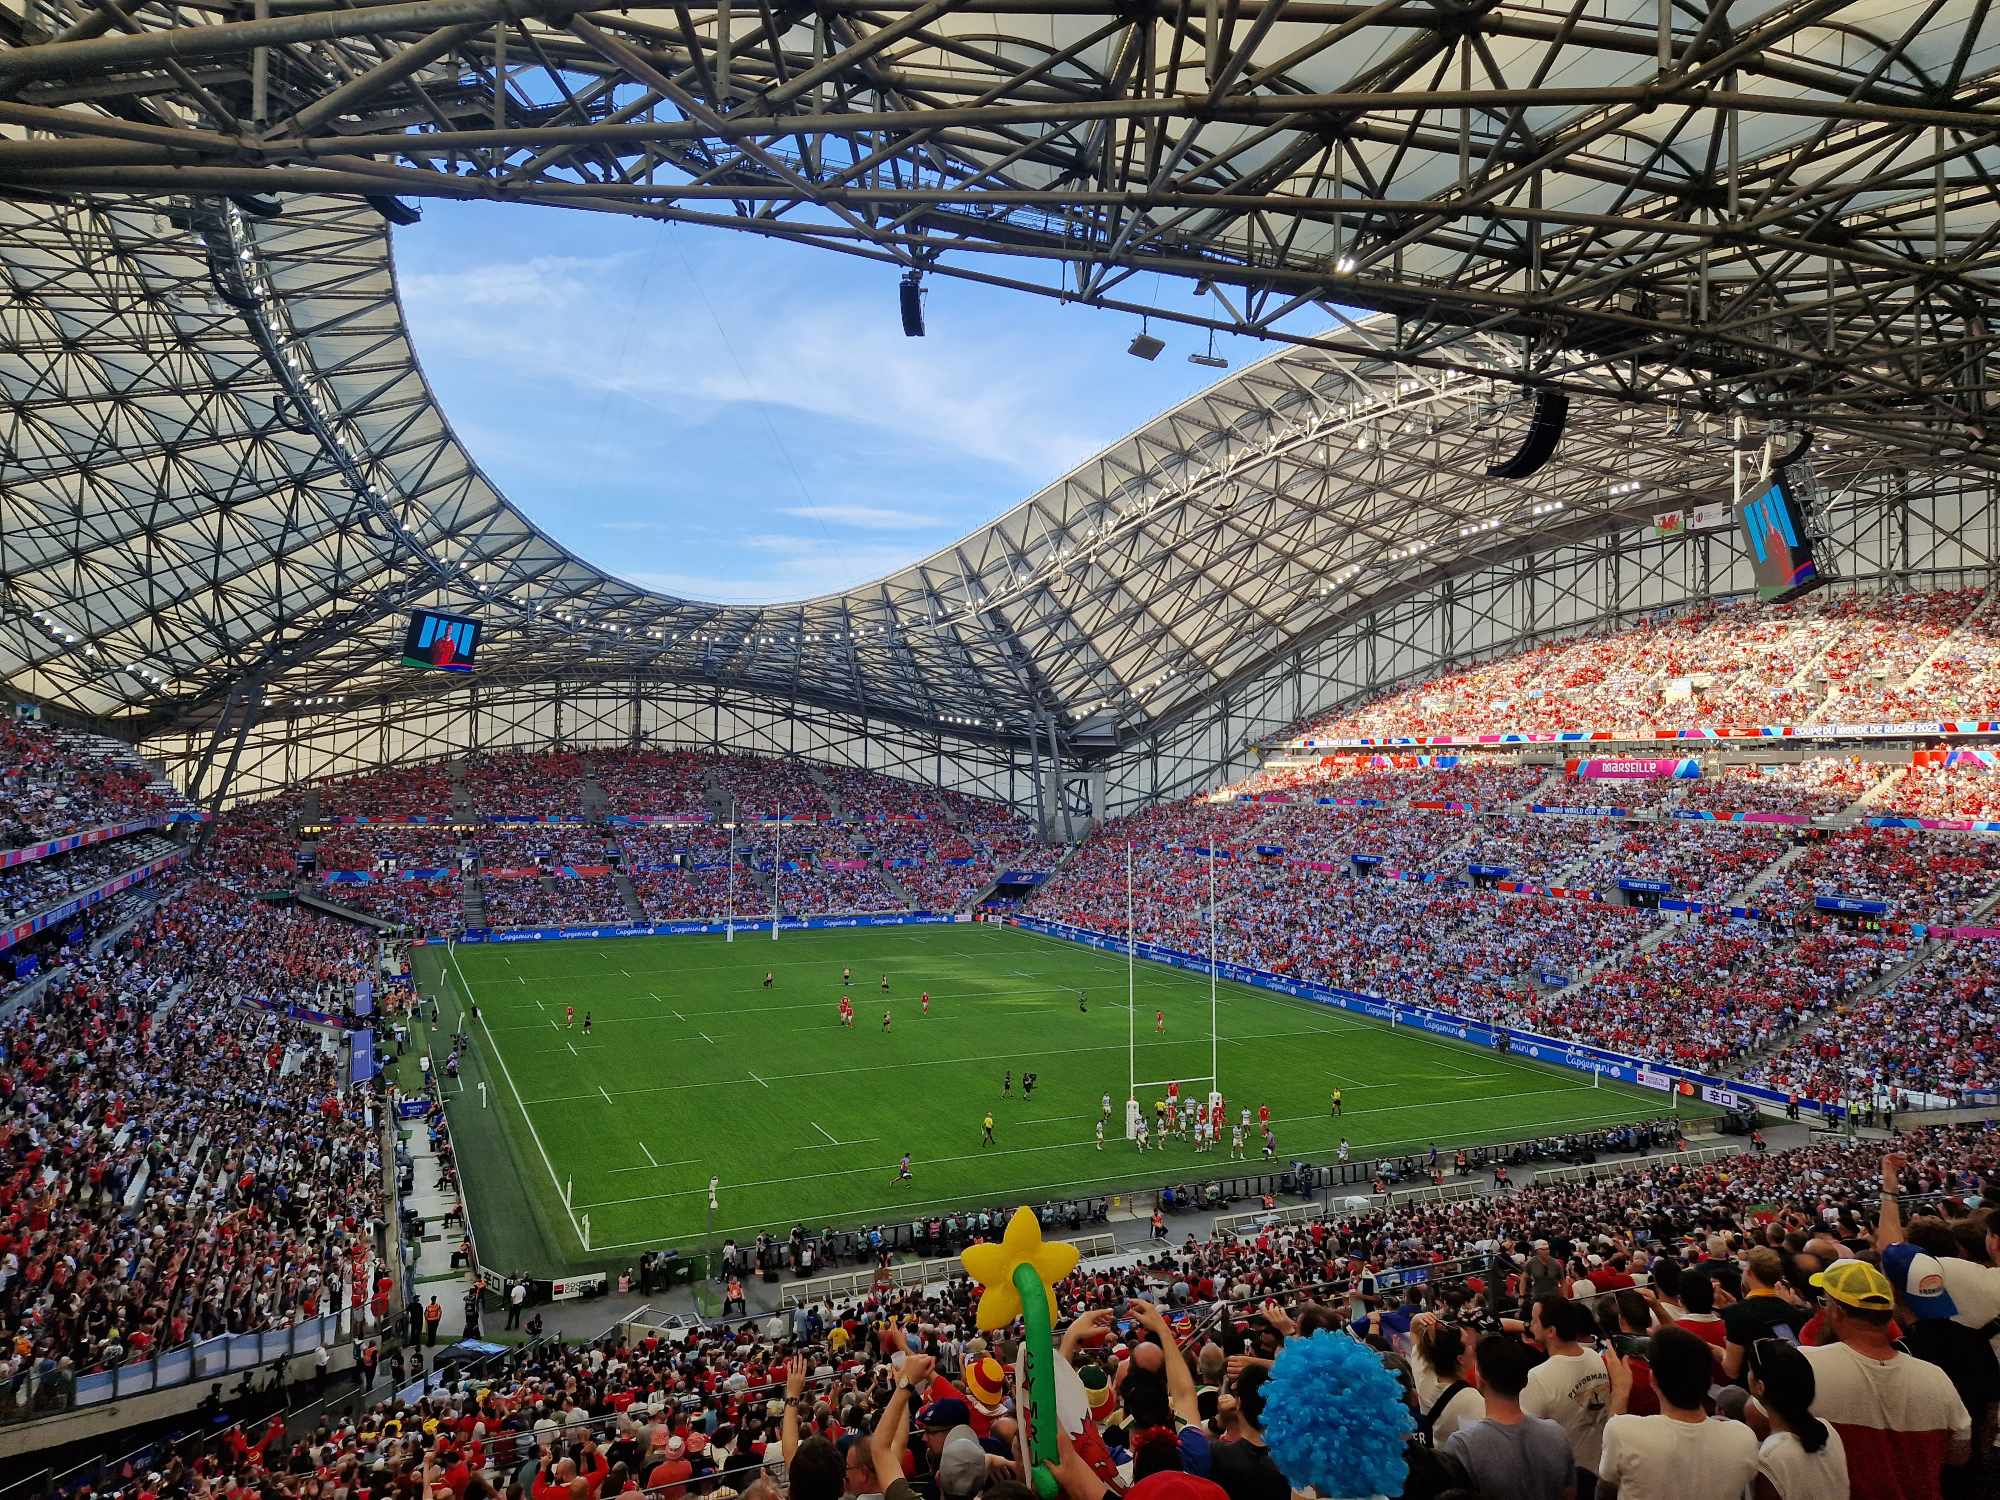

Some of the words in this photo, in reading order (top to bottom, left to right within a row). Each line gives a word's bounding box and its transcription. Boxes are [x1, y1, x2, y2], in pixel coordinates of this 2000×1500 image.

[1884, 724, 1915, 734] RUGBY
[1915, 723, 1939, 733] 2023
[1602, 761, 1656, 773] MARSEILLE
[1423, 1018, 1459, 1037] Capgemini
